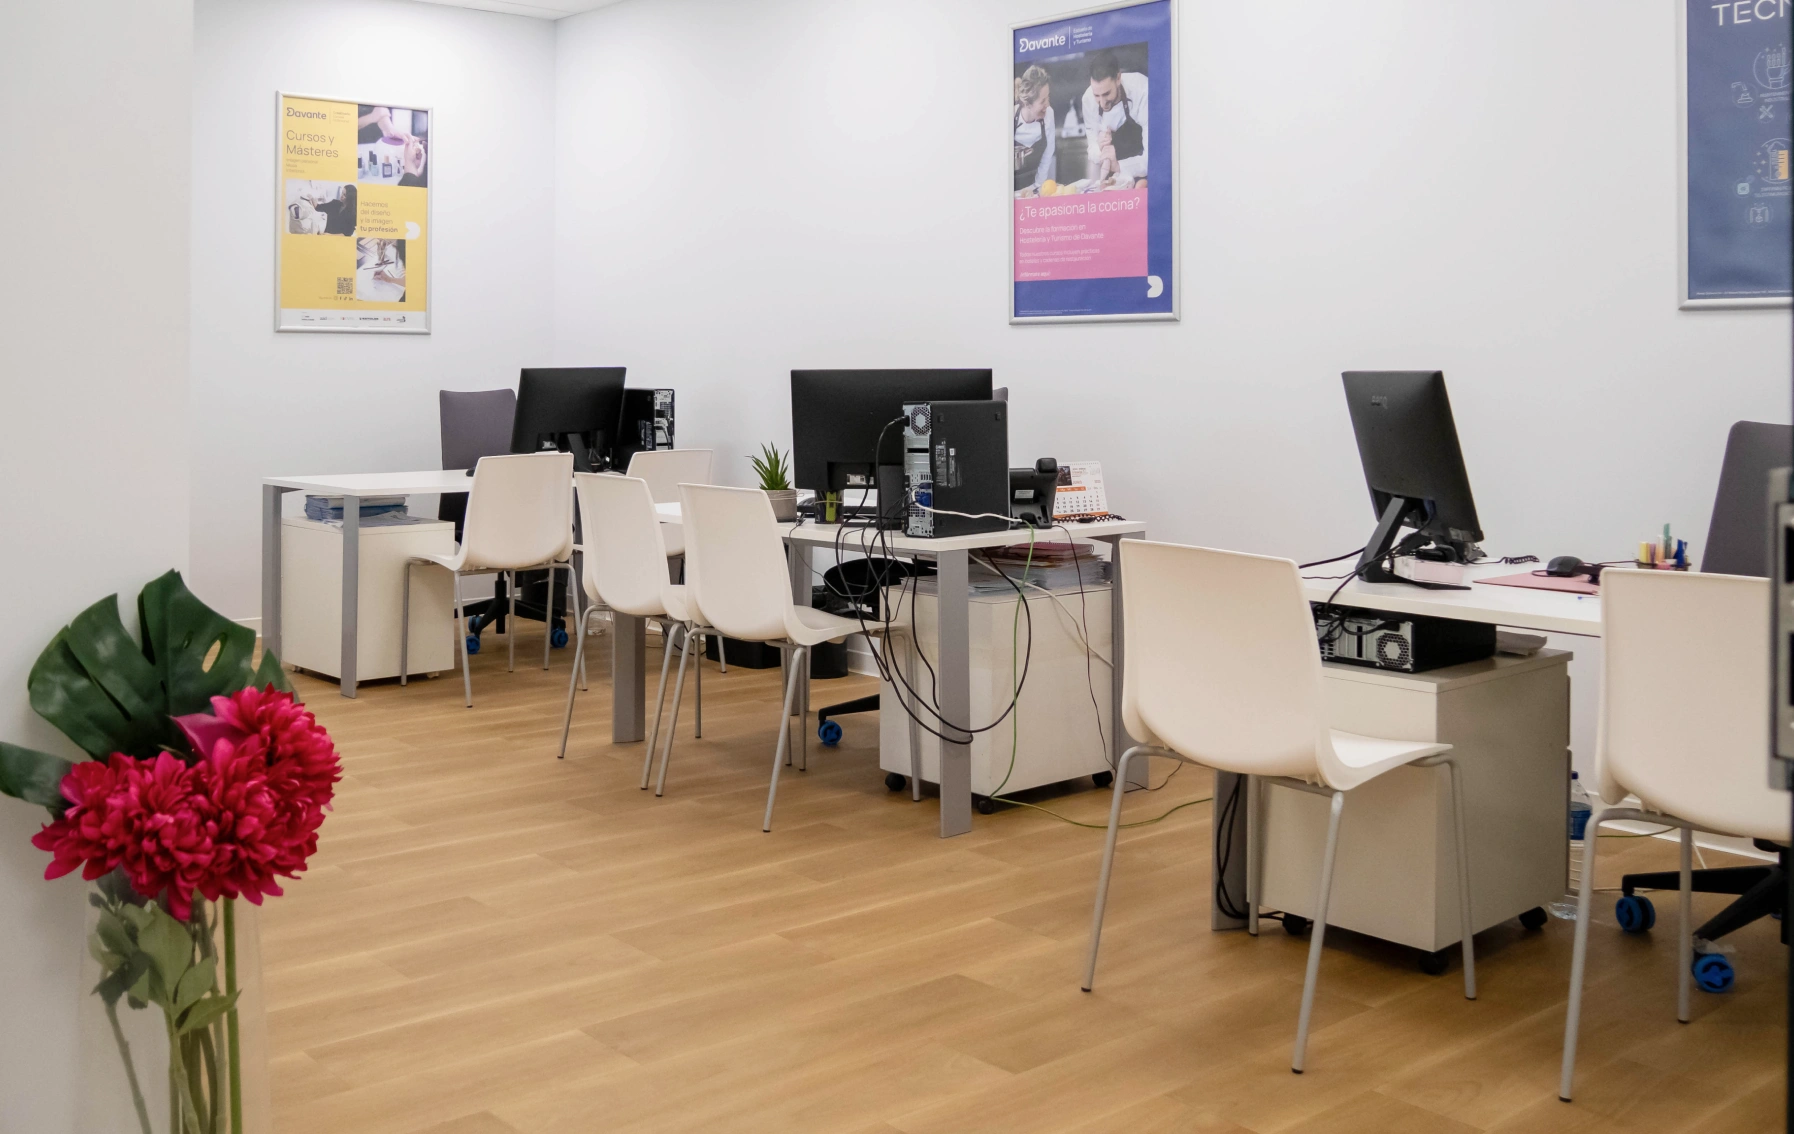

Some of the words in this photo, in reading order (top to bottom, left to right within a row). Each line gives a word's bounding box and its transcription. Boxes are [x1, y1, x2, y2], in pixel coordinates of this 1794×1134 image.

[1019, 34, 1066, 52] Davante
[286, 107, 327, 120] Davante
[286, 130, 326, 142] Cursos
[328, 136, 334, 146] y
[286, 144, 339, 158] Másteres
[1020, 206, 1037, 221] ¿Te
[1039, 202, 1085, 219] apasiona
[1087, 201, 1096, 213] la
[1098, 197, 1140, 212] cocina?
[1050, 224, 1078, 232] formación
